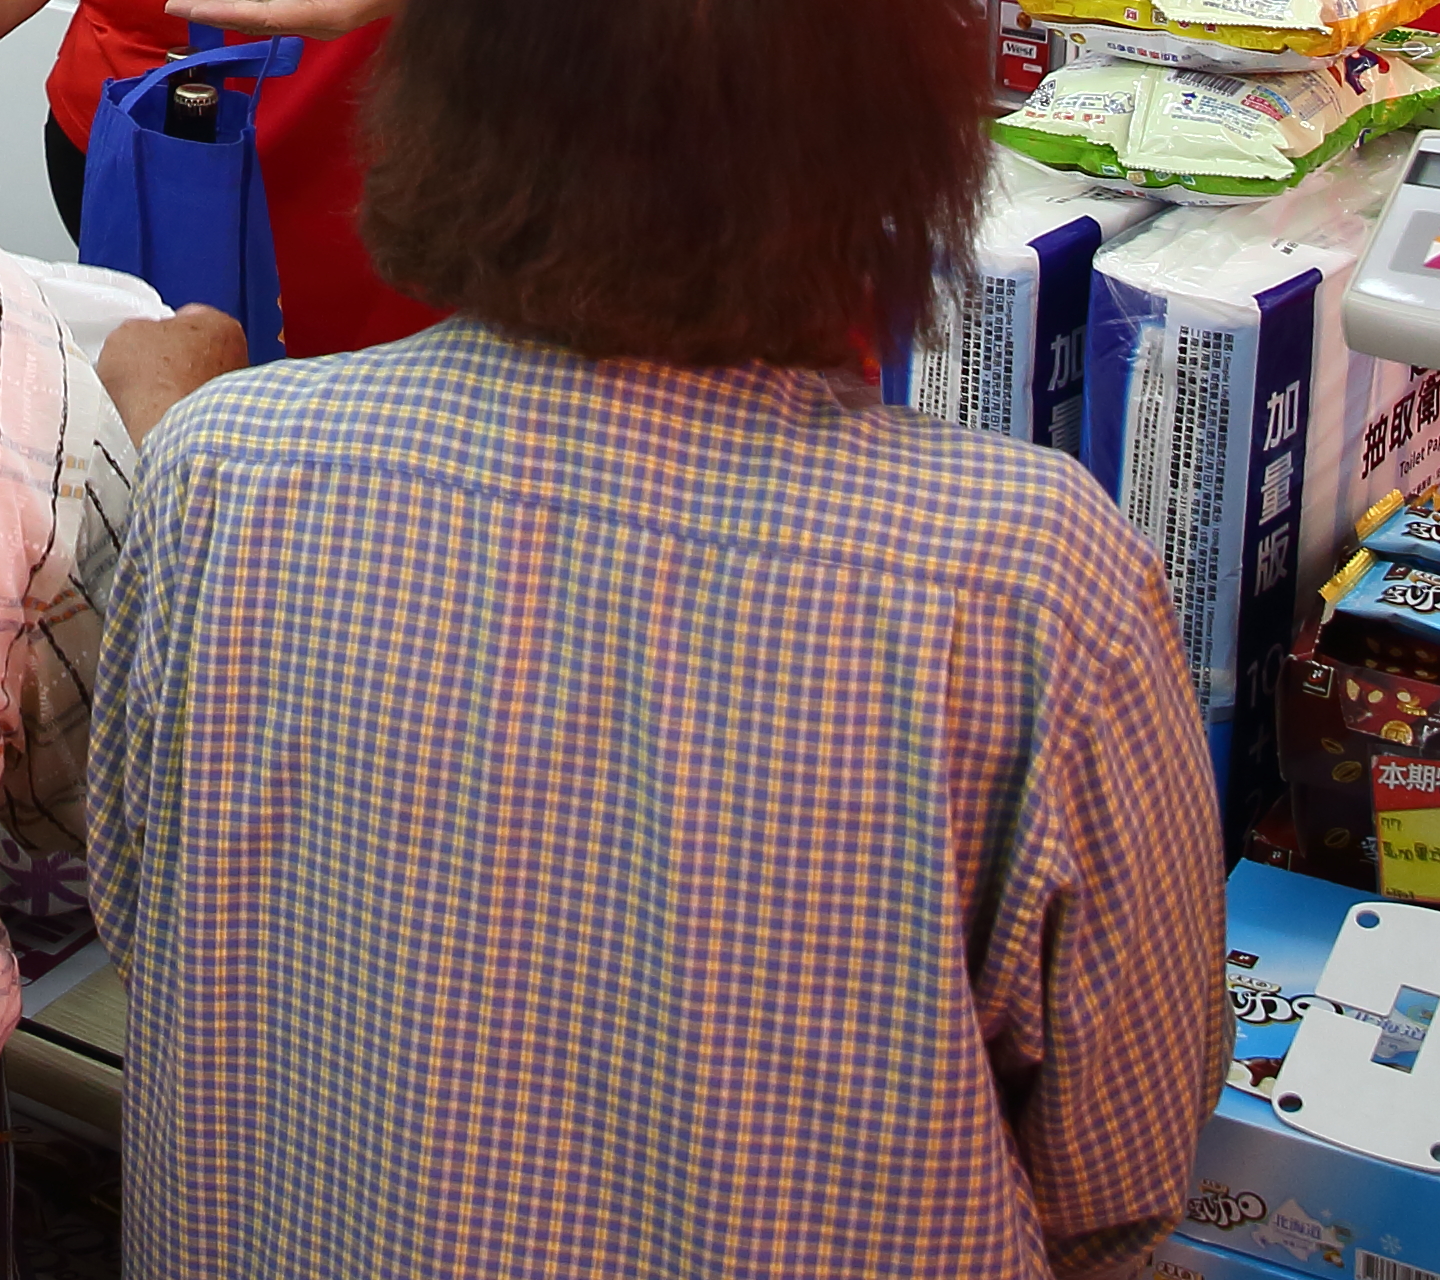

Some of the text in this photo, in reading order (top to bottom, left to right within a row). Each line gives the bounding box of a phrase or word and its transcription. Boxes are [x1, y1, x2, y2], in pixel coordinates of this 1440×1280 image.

[1255, 381, 1301, 596] 加量版
[1399, 446, 1426, 478] Toilet
